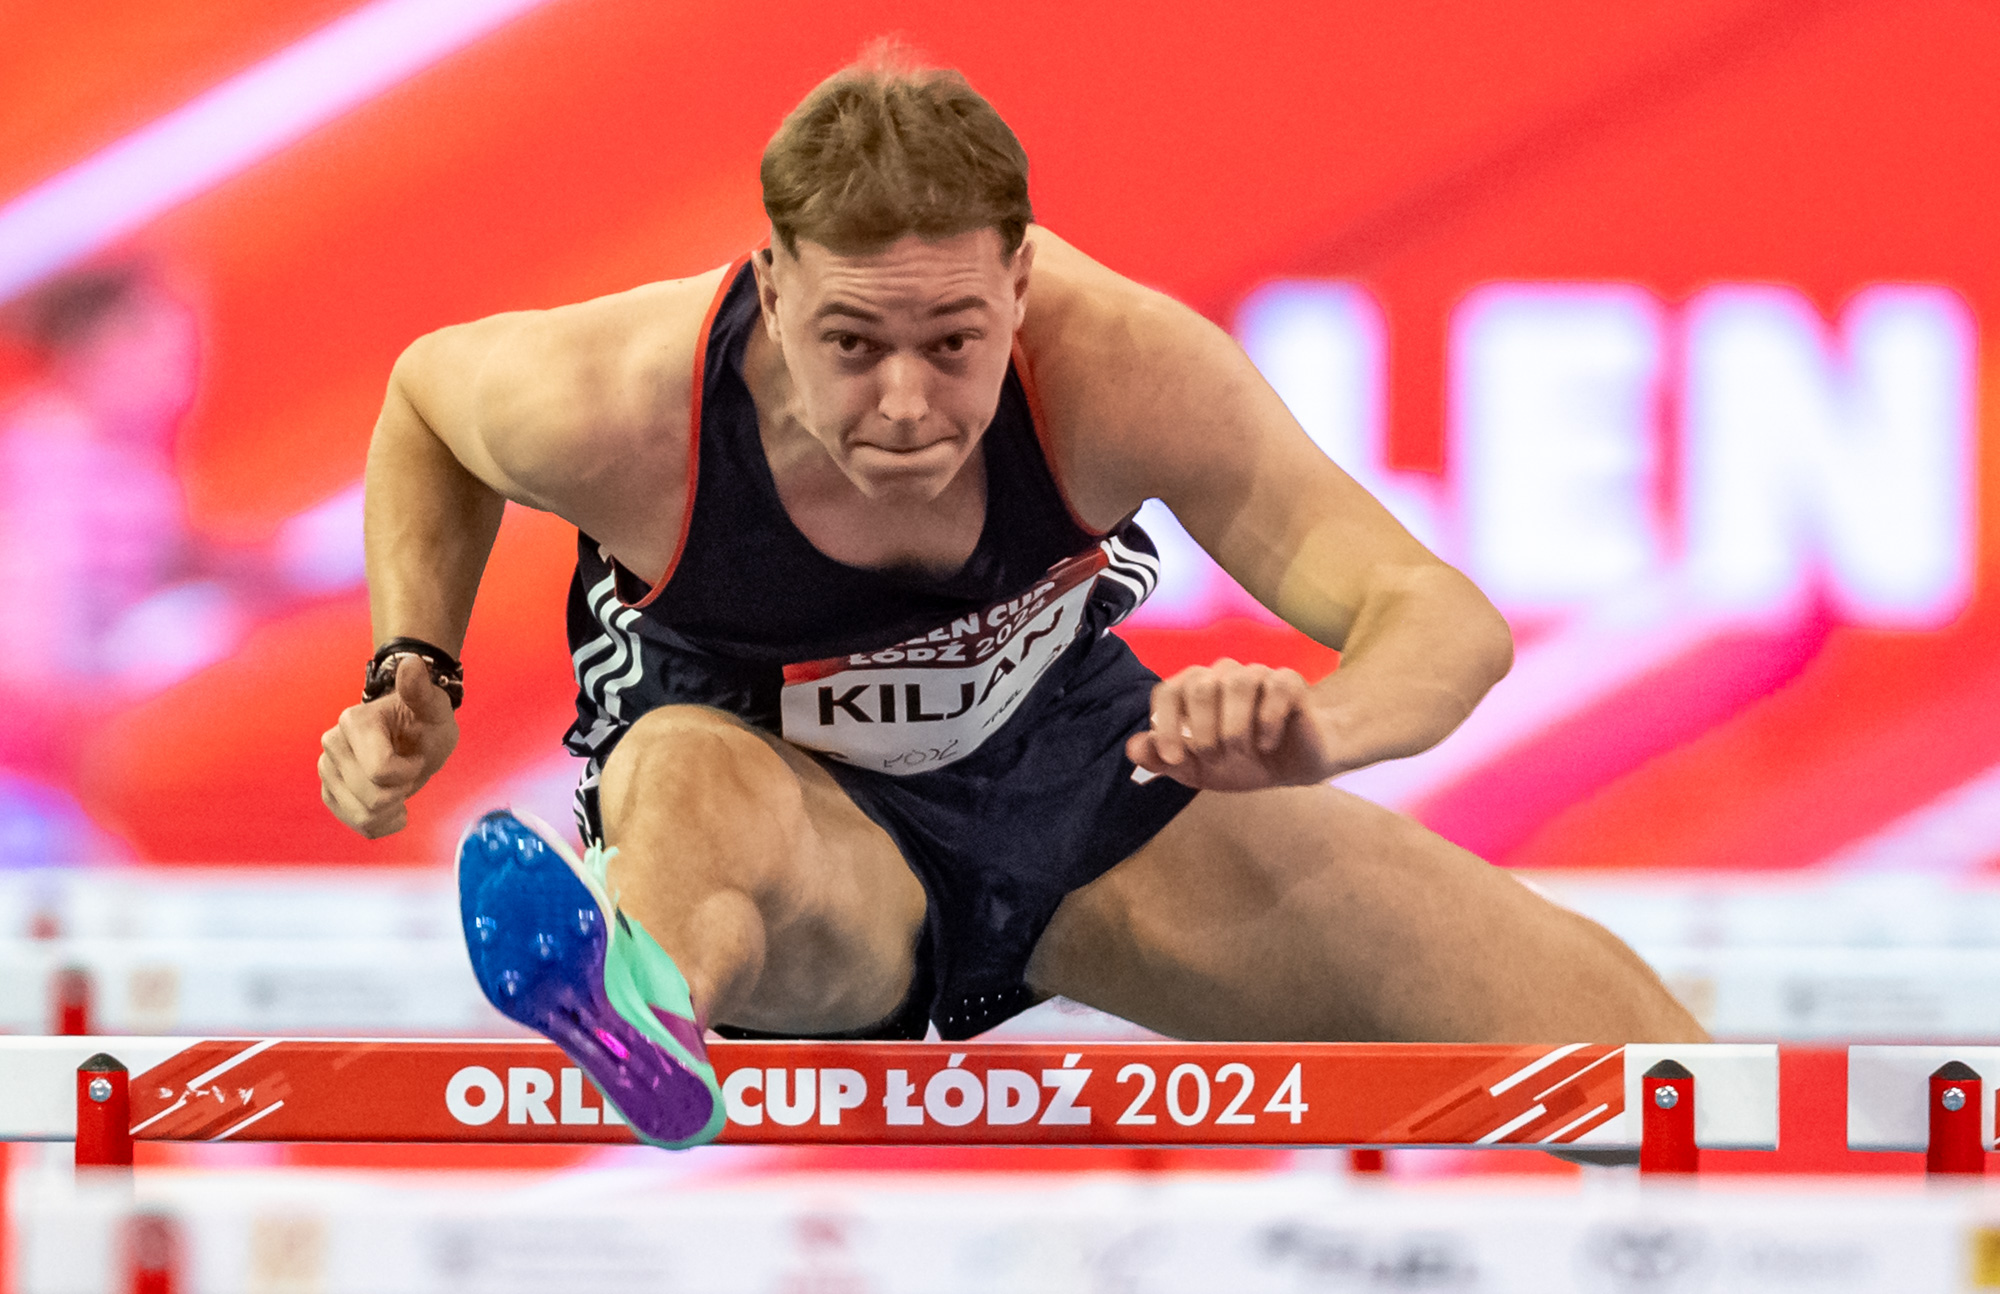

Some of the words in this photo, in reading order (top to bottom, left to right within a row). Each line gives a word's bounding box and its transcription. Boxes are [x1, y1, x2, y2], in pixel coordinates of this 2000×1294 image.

[1232, 282, 1979, 630] LEN
[976, 597, 1047, 659] 2024
[986, 581, 1055, 627] CUP
[818, 604, 1064, 726] KILJAN
[445, 1065, 628, 1126] ORL
[722, 1067, 868, 1126] CUP
[882, 1053, 1093, 1126] ŁÓDŹ
[1116, 1062, 1308, 1126] 2024
